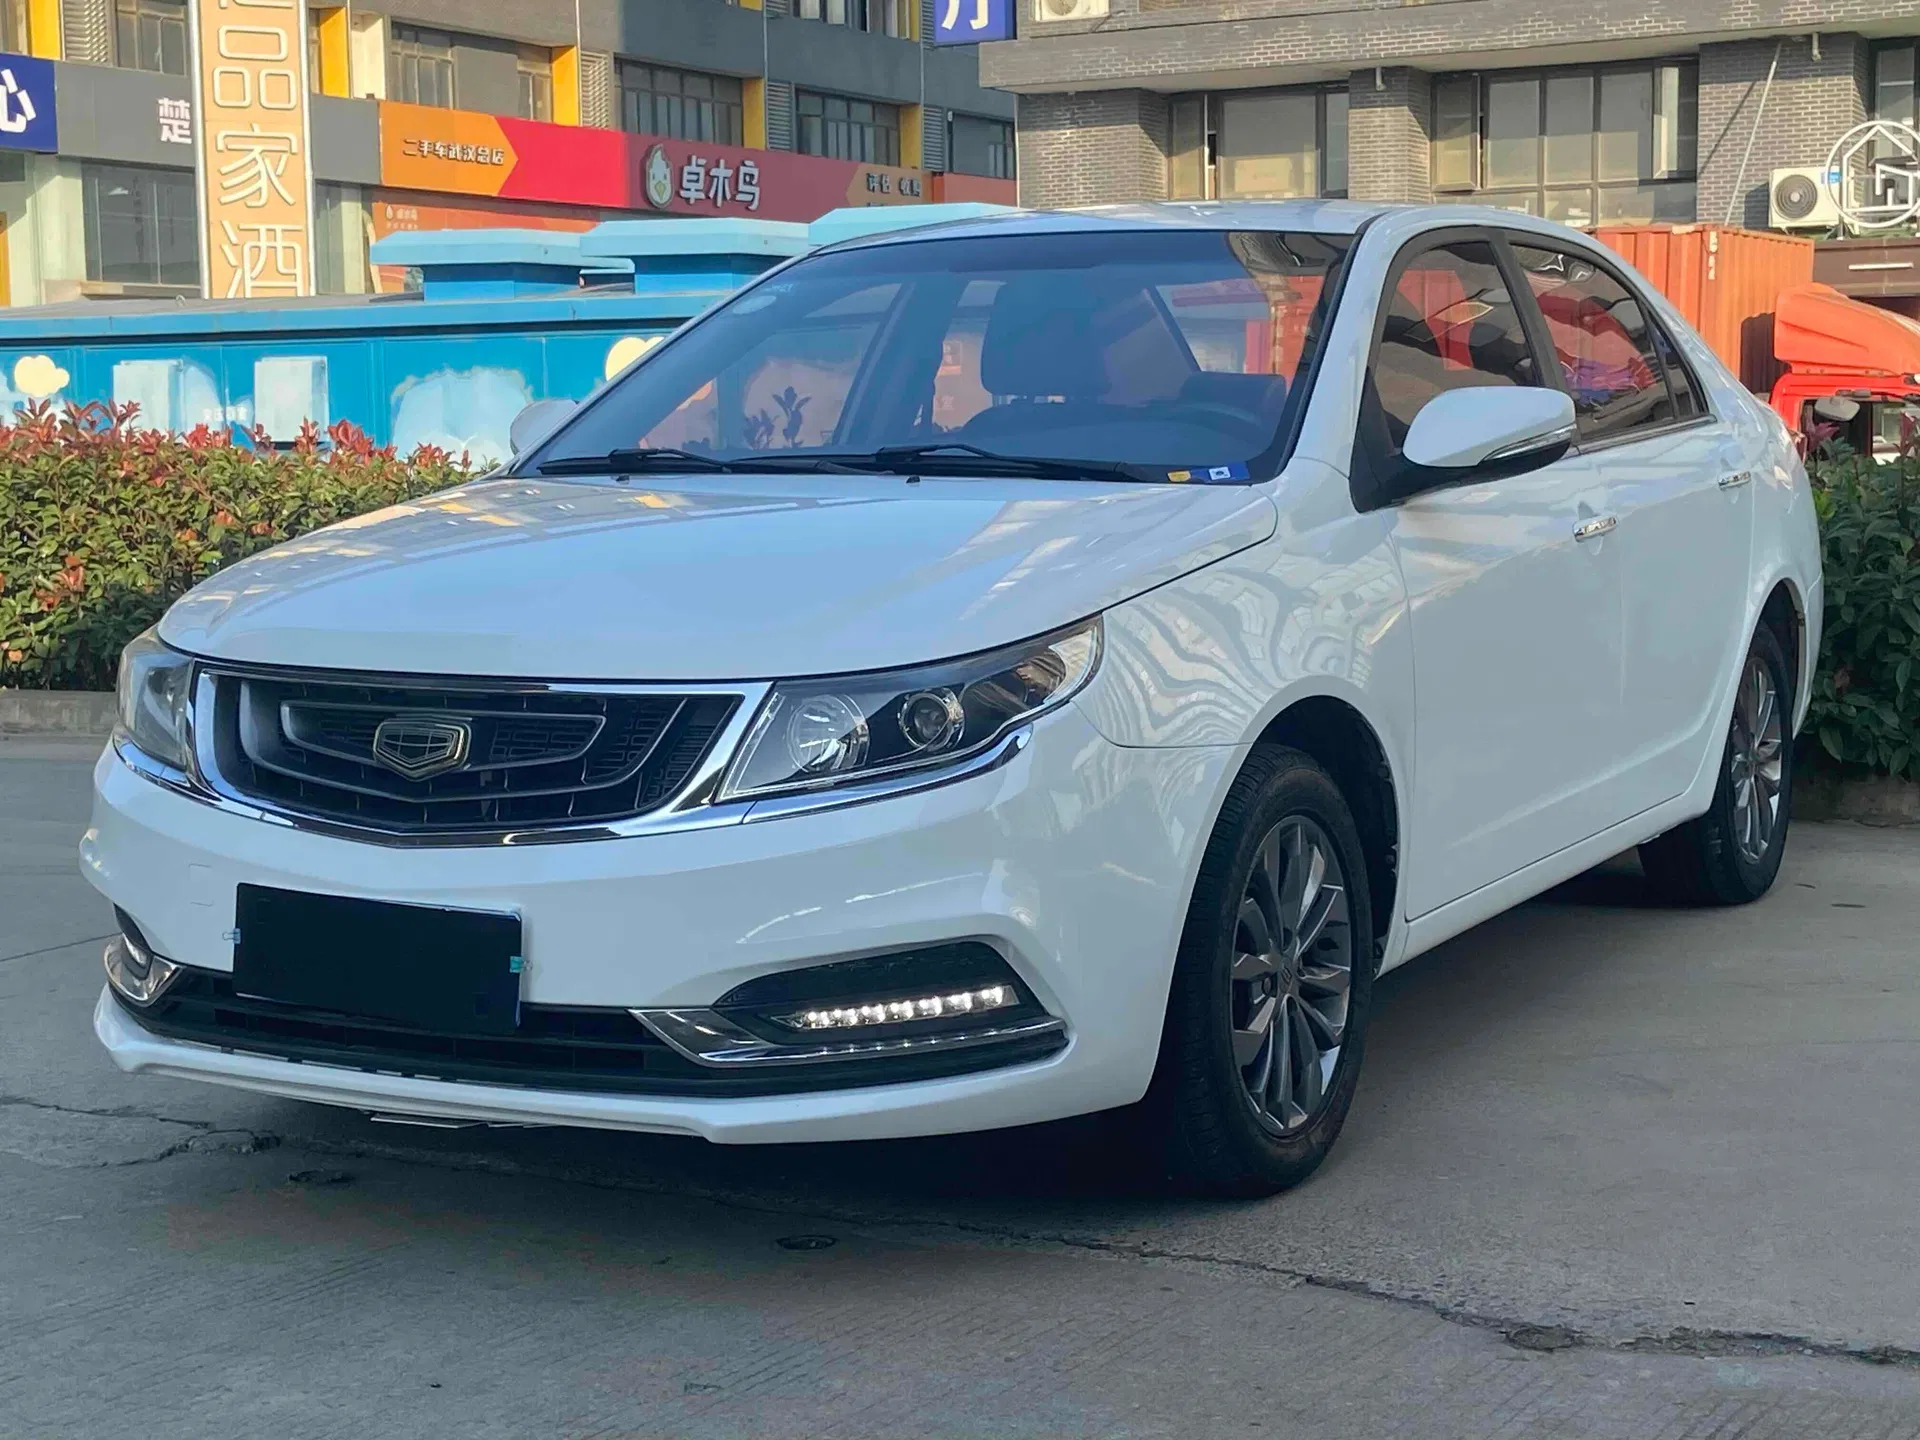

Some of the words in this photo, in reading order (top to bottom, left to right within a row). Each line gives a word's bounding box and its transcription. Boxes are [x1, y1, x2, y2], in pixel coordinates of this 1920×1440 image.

[158, 97, 192, 144] 楚
[213, 0, 303, 298] 品家酒
[403, 139, 504, 166] 二手车武汉总店
[679, 154, 761, 211] 卓木鸟
